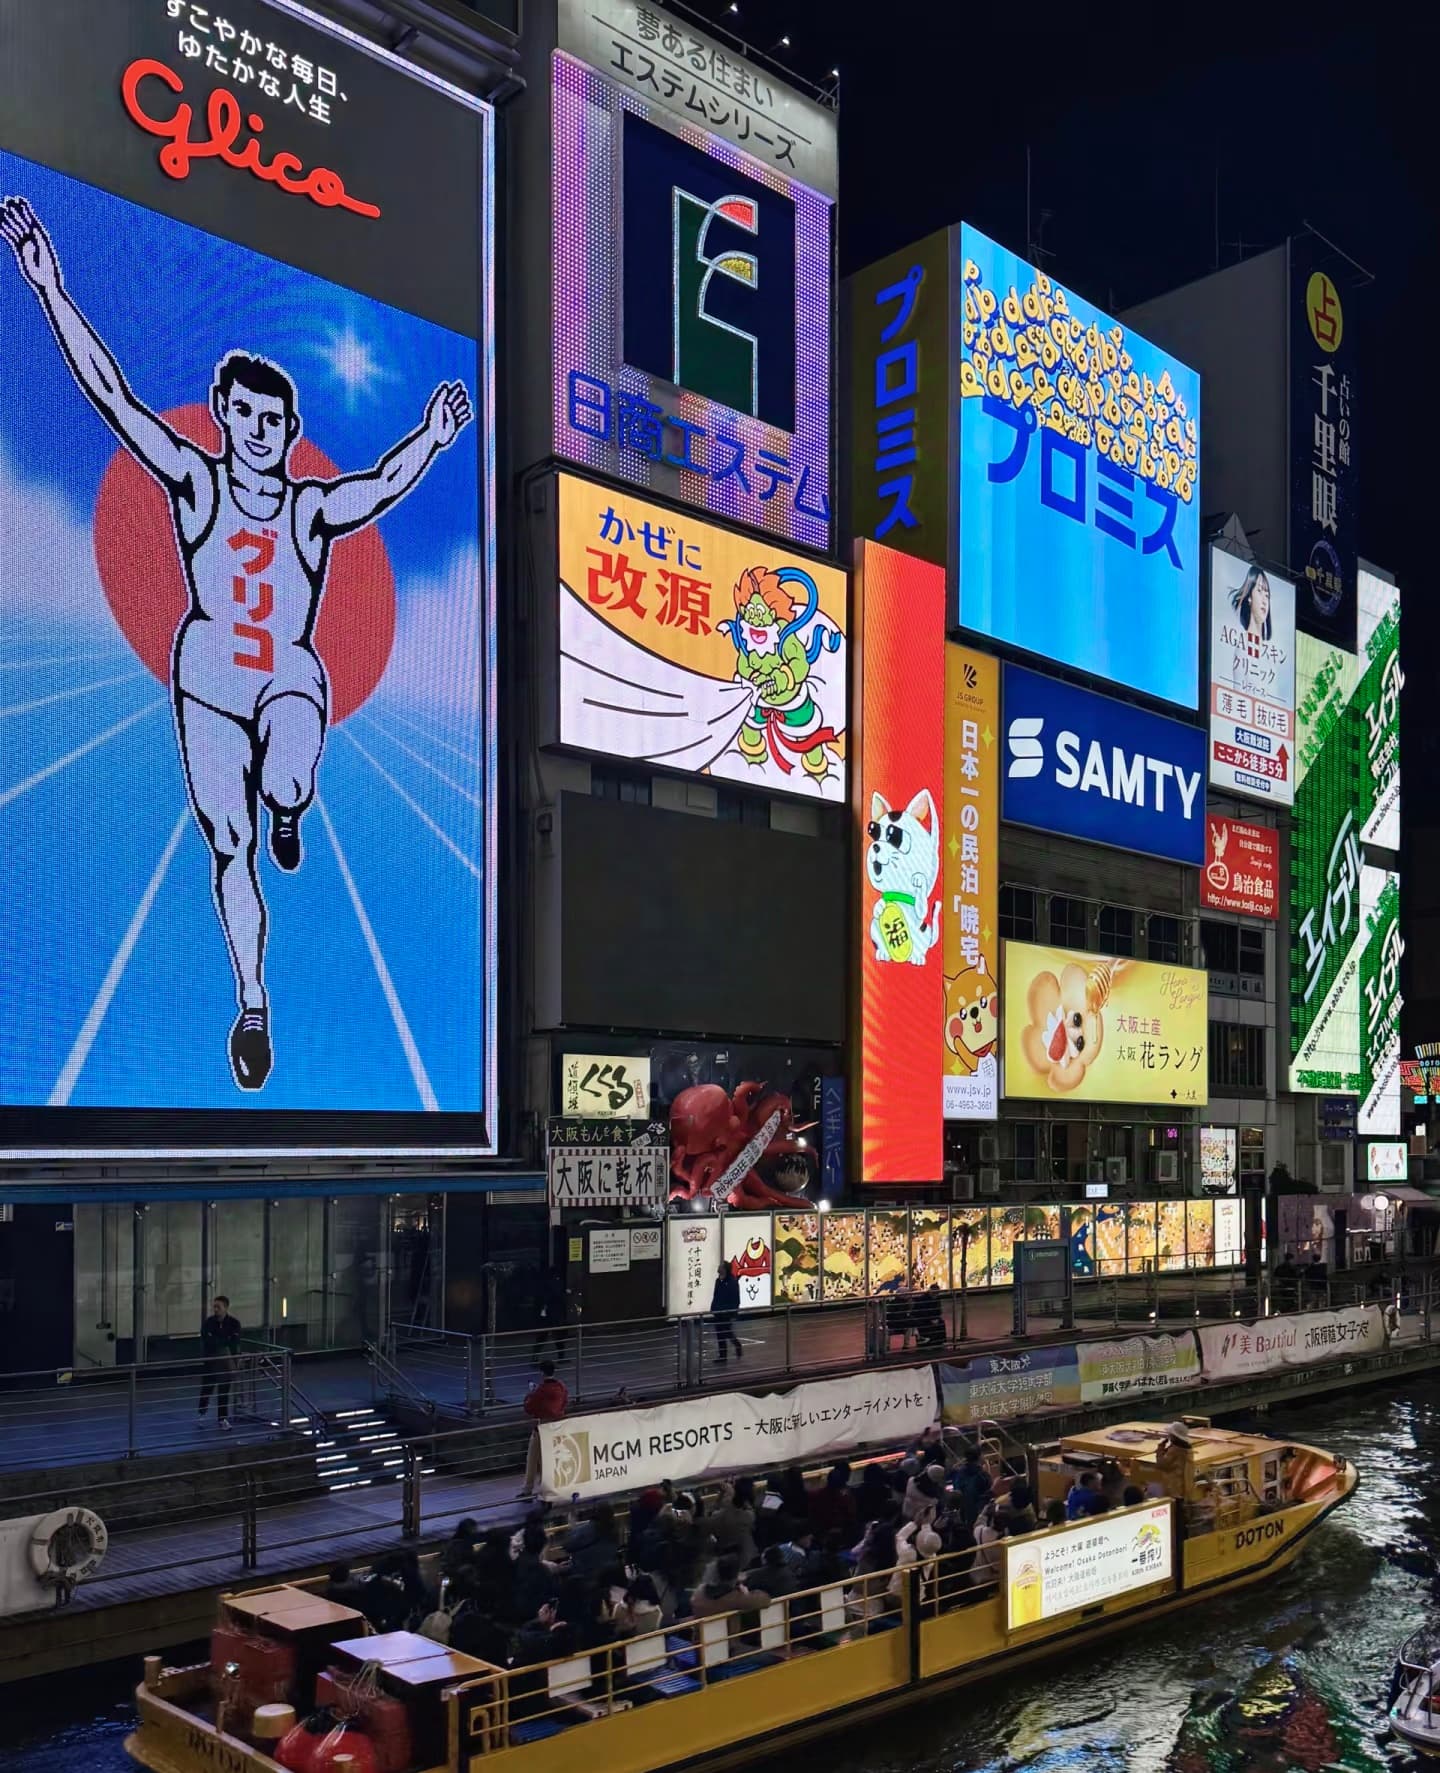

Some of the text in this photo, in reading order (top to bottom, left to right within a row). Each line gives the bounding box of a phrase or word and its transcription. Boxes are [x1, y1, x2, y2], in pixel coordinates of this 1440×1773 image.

[165, 0, 348, 101] すこやかな毎日、
[178, 32, 331, 124] ゆたかな人生
[637, 5, 775, 109] 夢ある住まい
[121, 58, 382, 220] Glico
[610, 40, 799, 169] エステムシリーズ
[875, 264, 926, 540] プロミス
[568, 369, 832, 522] 日商エステム
[981, 395, 1185, 572] プロミス
[1311, 363, 1338, 537] 千里眼
[598, 505, 703, 571] かぜに
[226, 527, 279, 674] グリコ
[585, 546, 713, 637] 改源
[1219, 624, 1288, 665] AGA スキン
[1232, 655, 1276, 685] クリニック
[1256, 704, 1287, 734] 抜け毛
[1055, 730, 1201, 820] SAMTY
[1217, 745, 1284, 779] ここから徒歩5分
[1299, 817, 1366, 990] エイブル
[1116, 1014, 1162, 1037] 大阪土産
[1116, 1040, 1205, 1073] 大阪 花ラング
[579, 1063, 634, 1110] くくる
[551, 1125, 637, 1143] 大阪もんを食す
[556, 1156, 653, 1196] 大阪に乾杯
[593, 1421, 734, 1465] MGM RESORTS
[595, 1465, 628, 1481] JAPAN
[1235, 1519, 1285, 1550] DOTON
